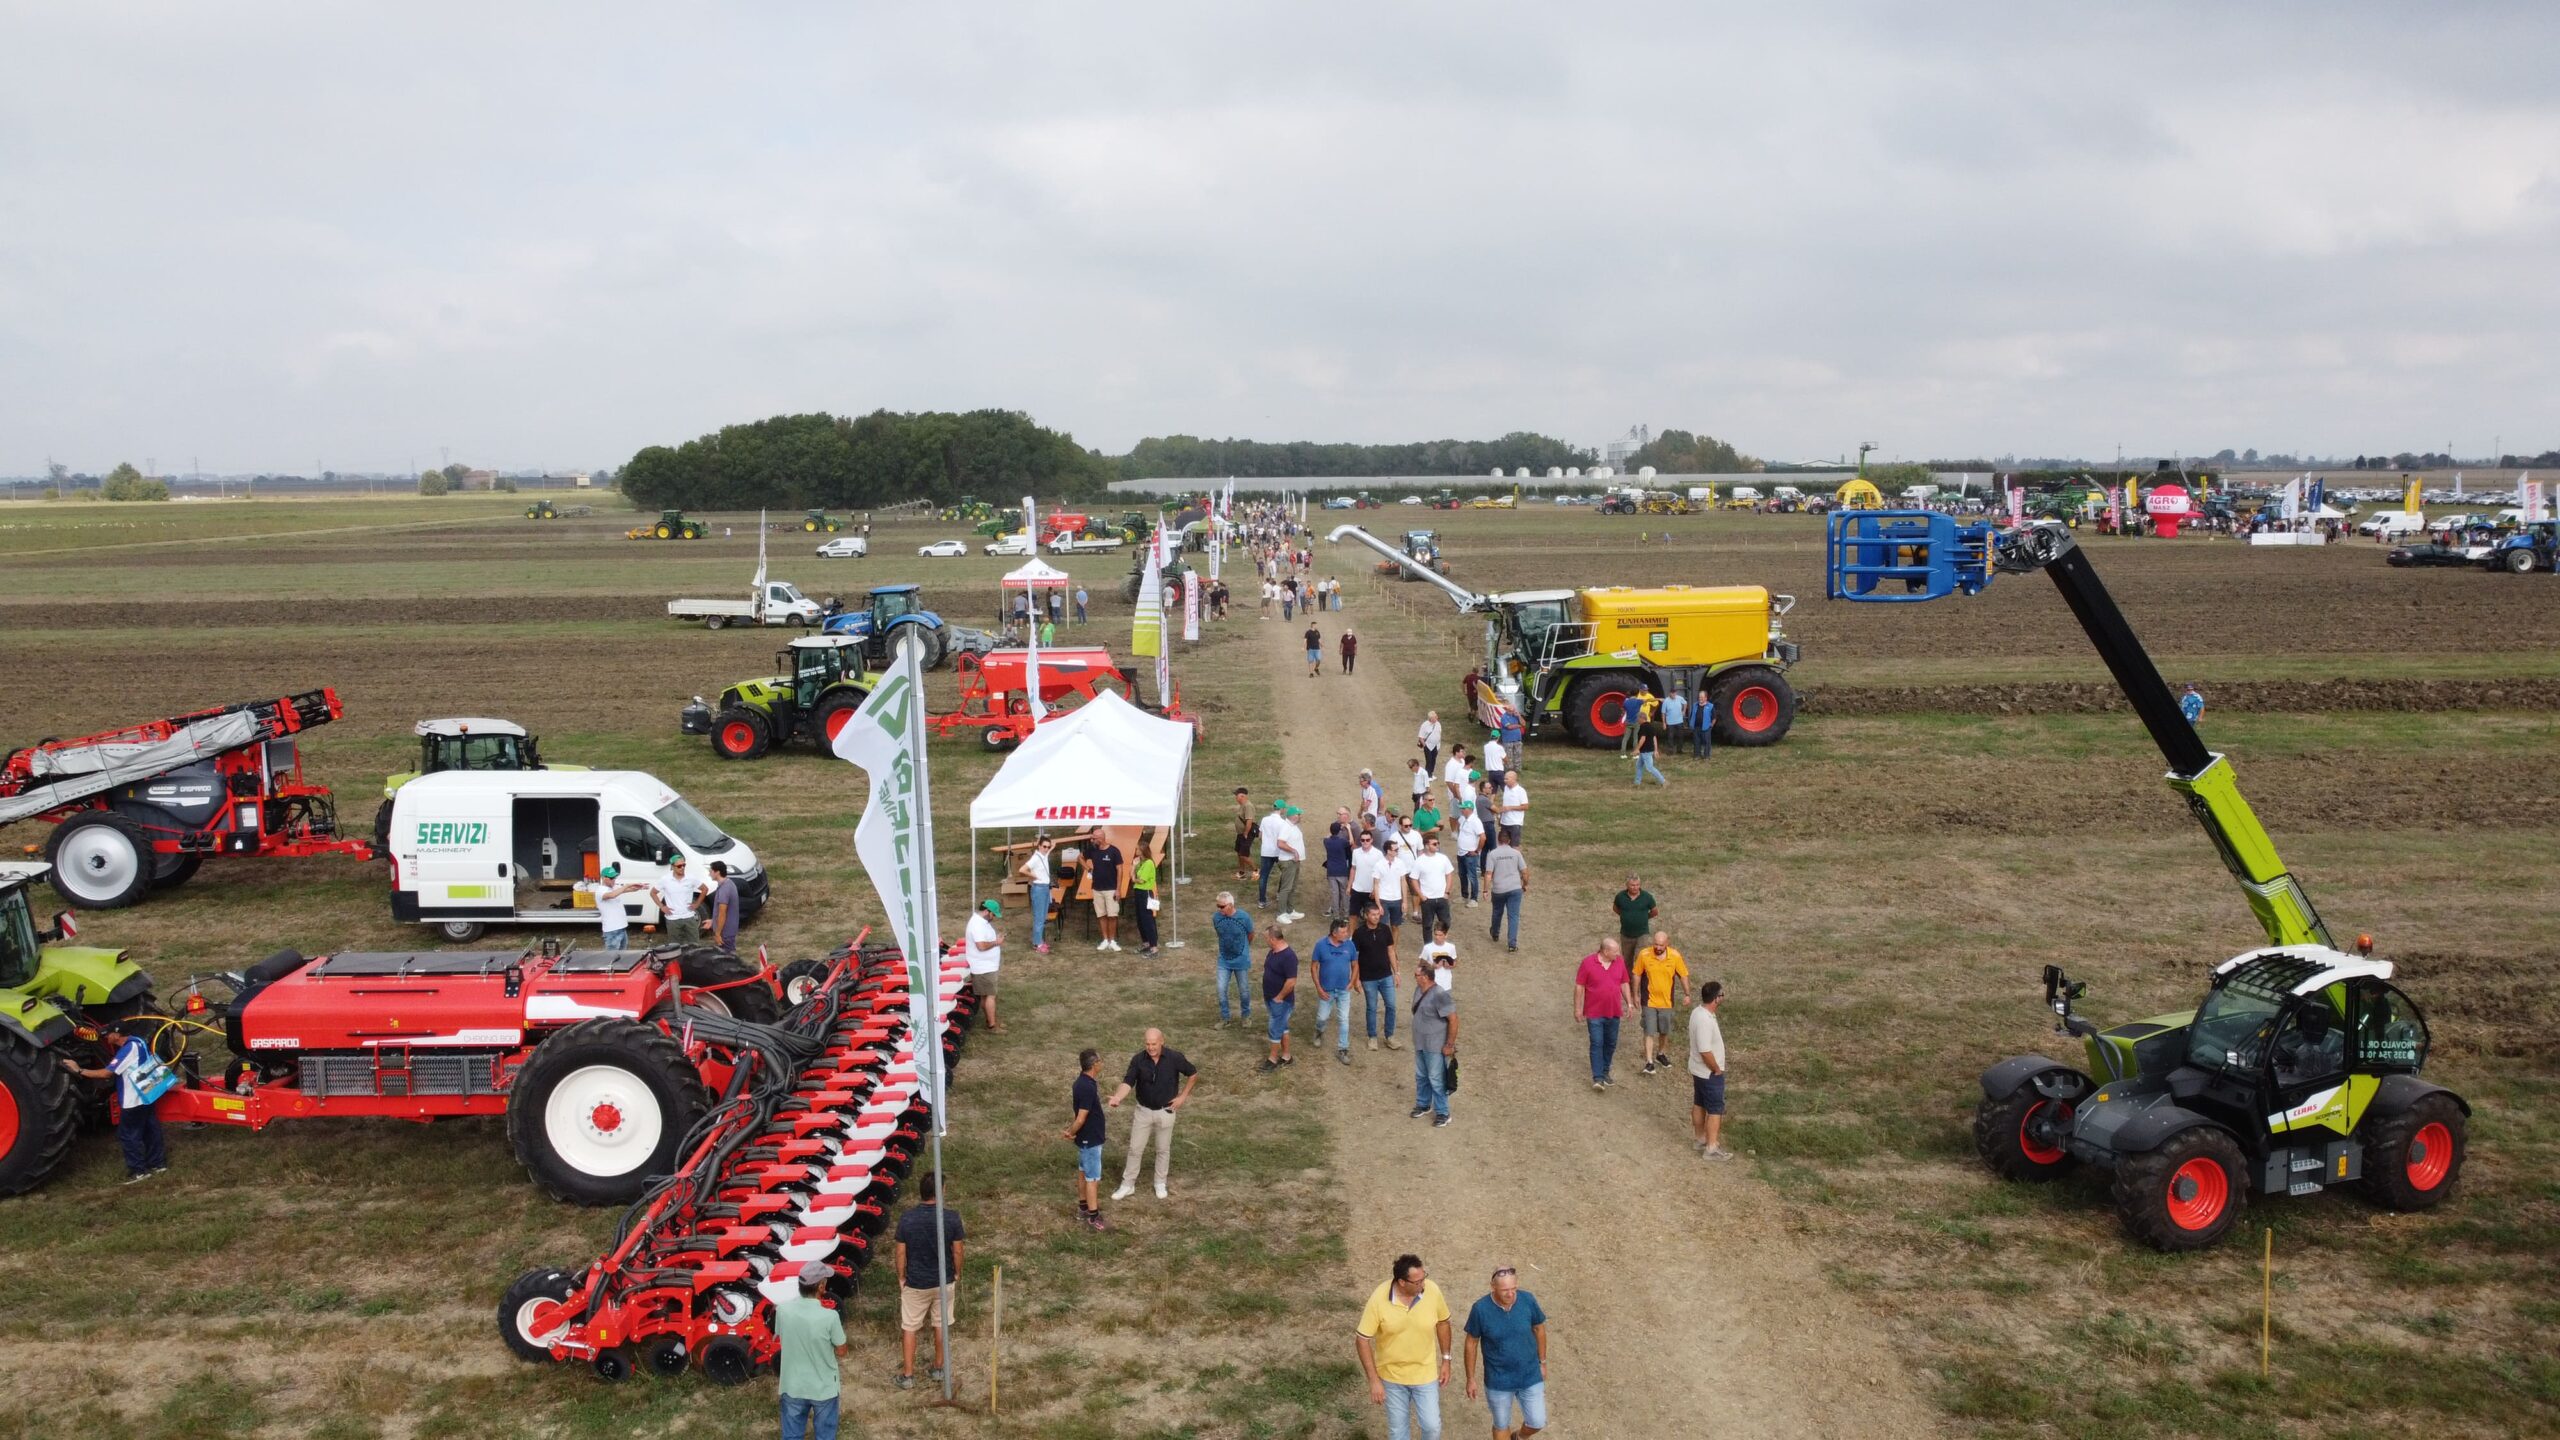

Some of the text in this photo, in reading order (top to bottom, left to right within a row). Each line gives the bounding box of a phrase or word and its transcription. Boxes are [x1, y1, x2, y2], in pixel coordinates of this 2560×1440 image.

[1035, 806, 1111, 819] CLAAS
[417, 823, 487, 844] SERVIZI
[251, 1038, 300, 1048] GASPARDO
[2293, 1104, 2317, 1117] CLAAS
